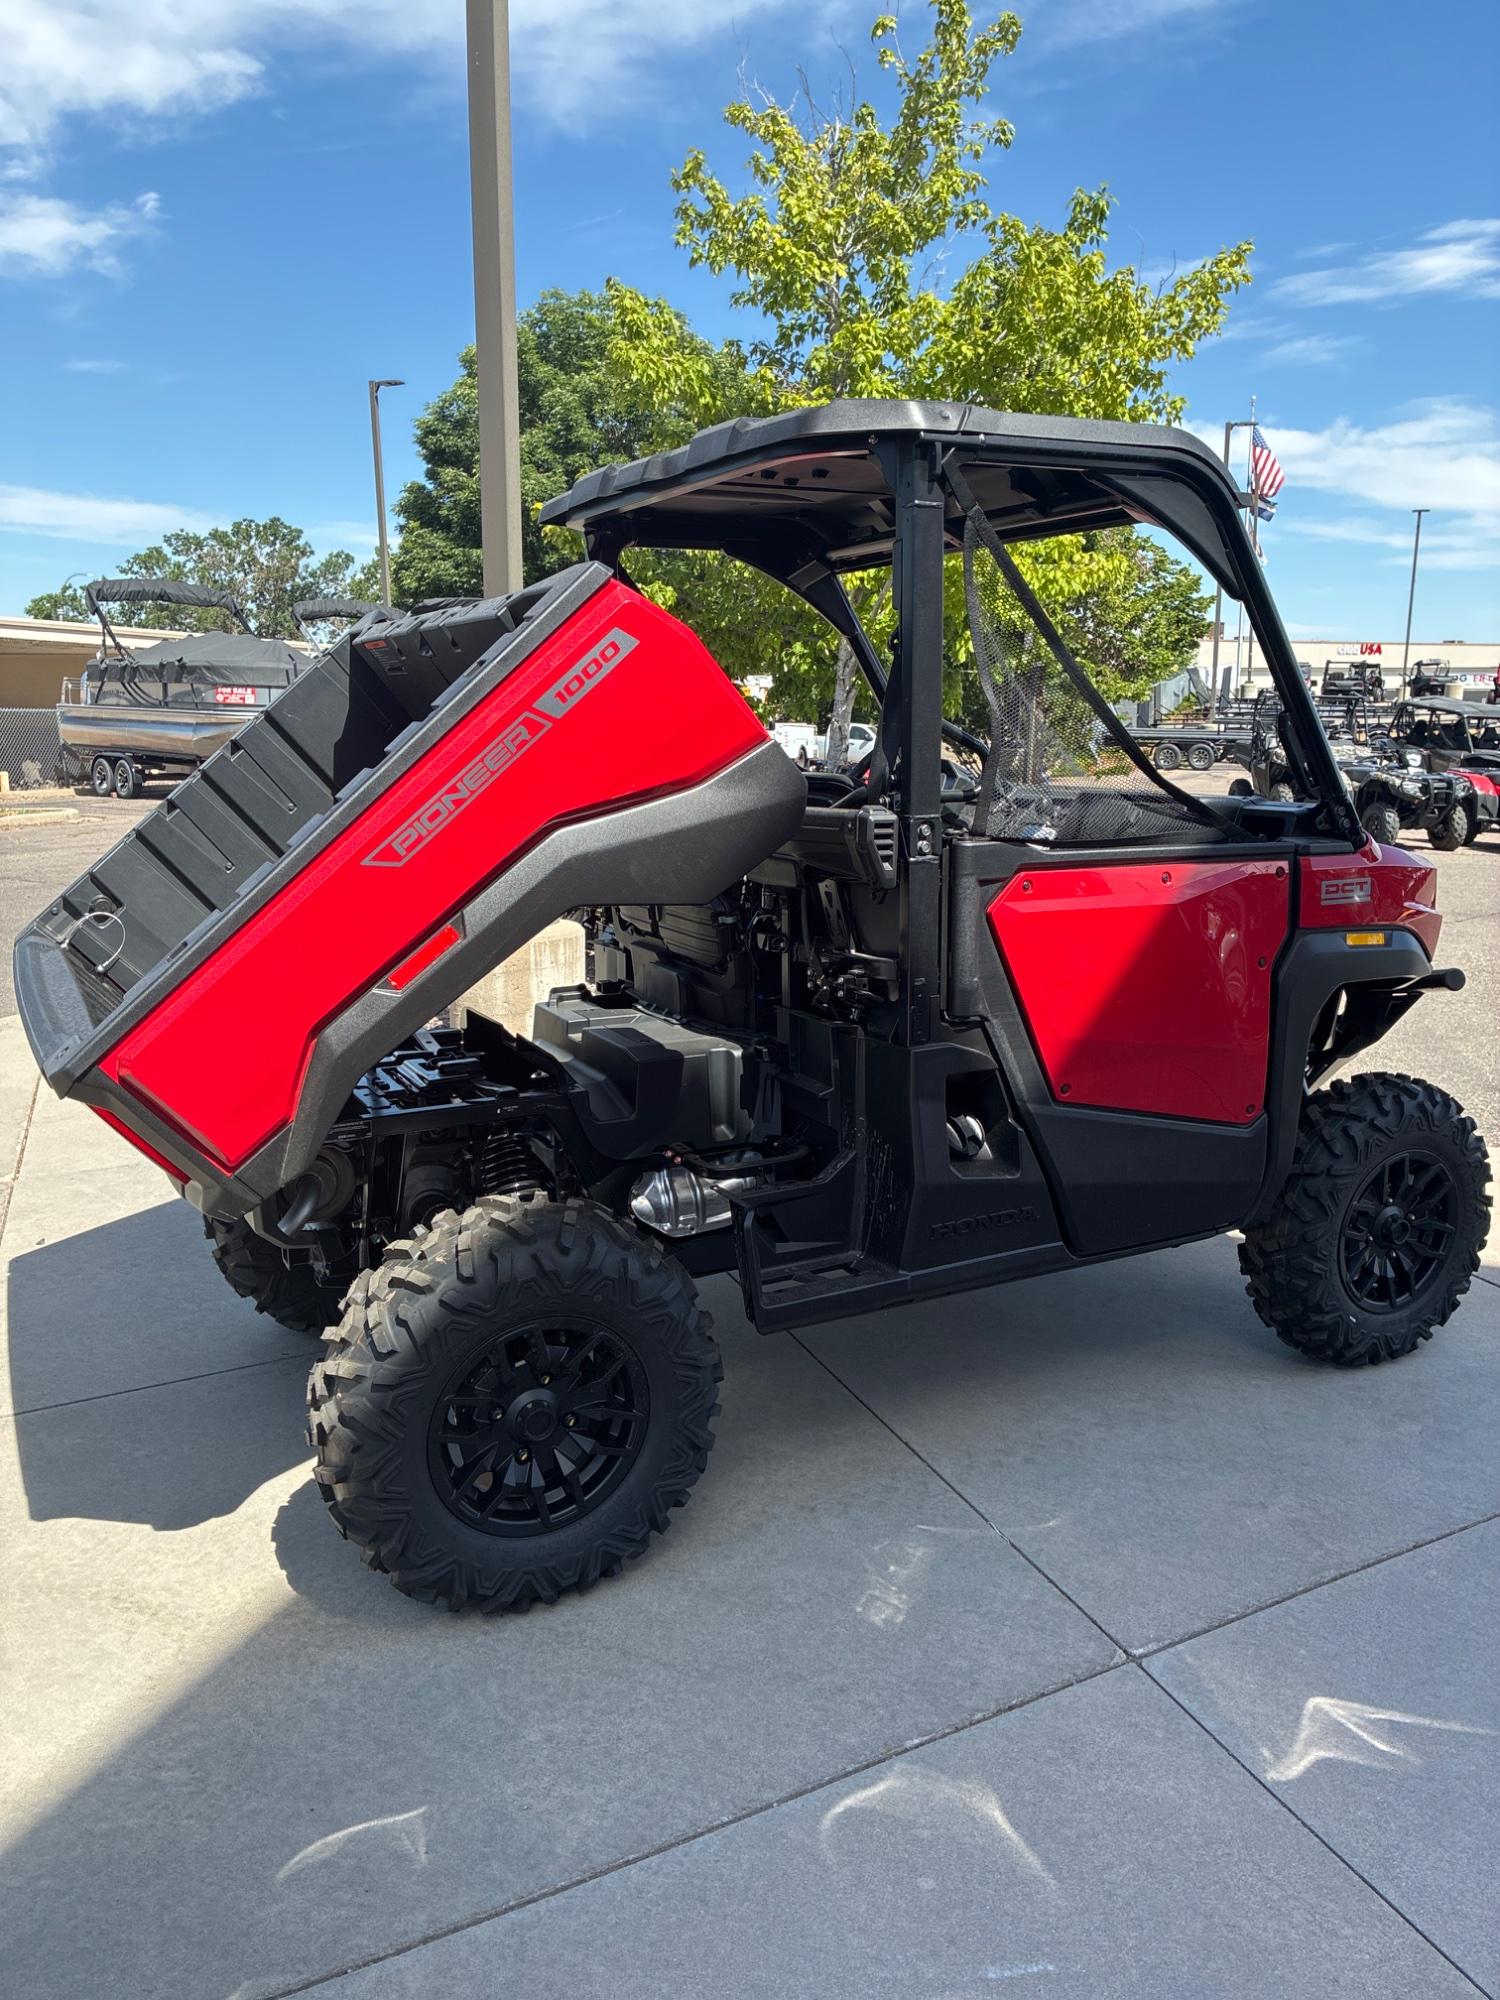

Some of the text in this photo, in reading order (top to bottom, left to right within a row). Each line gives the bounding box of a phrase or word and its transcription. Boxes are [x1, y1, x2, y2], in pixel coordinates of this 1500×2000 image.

[391, 640, 621, 856] PIONEER 1000
[1325, 881, 1368, 895] DCT
[929, 1206, 1039, 1240] HONDA
